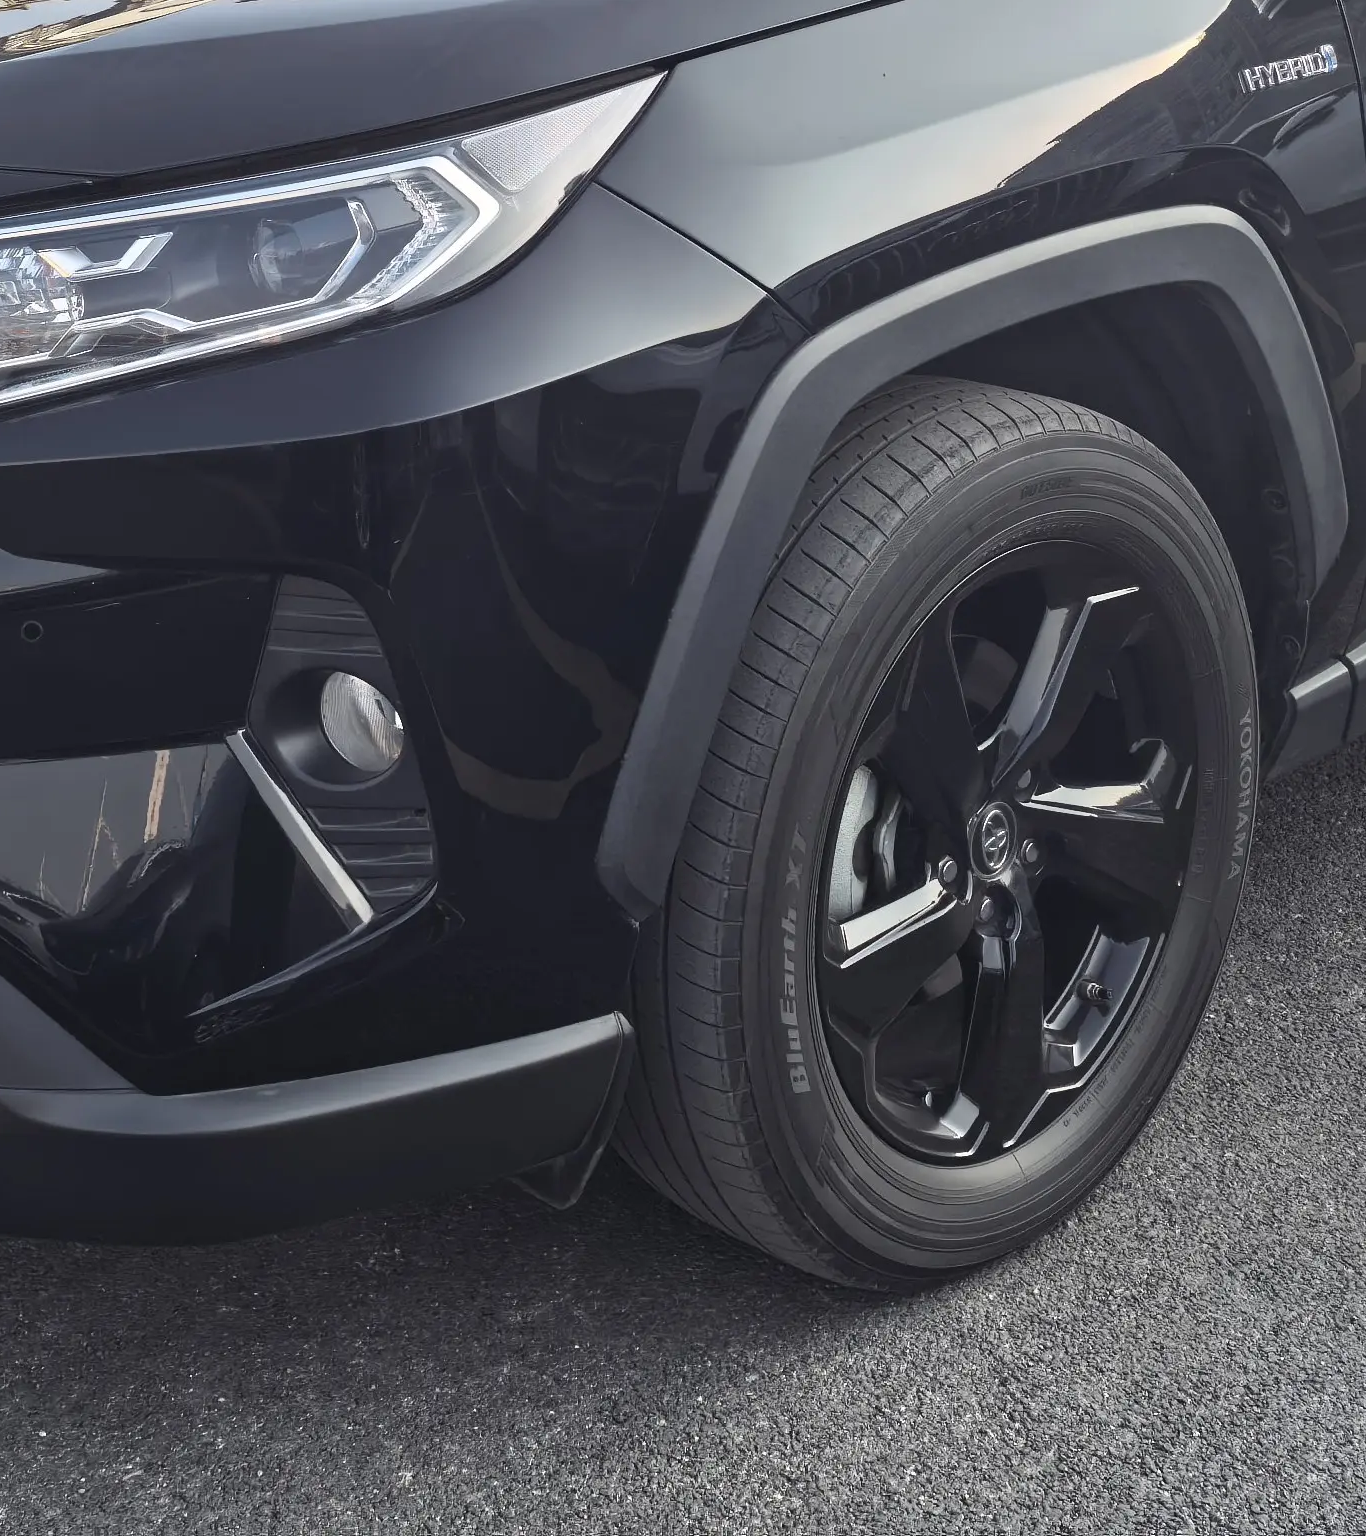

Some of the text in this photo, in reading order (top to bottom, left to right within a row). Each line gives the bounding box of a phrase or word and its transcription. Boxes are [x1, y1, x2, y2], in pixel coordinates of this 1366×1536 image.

[1241, 52, 1329, 92] HYBRID
[1227, 707, 1252, 880] YOKOHAMA
[779, 907, 812, 1094] BluEarth
